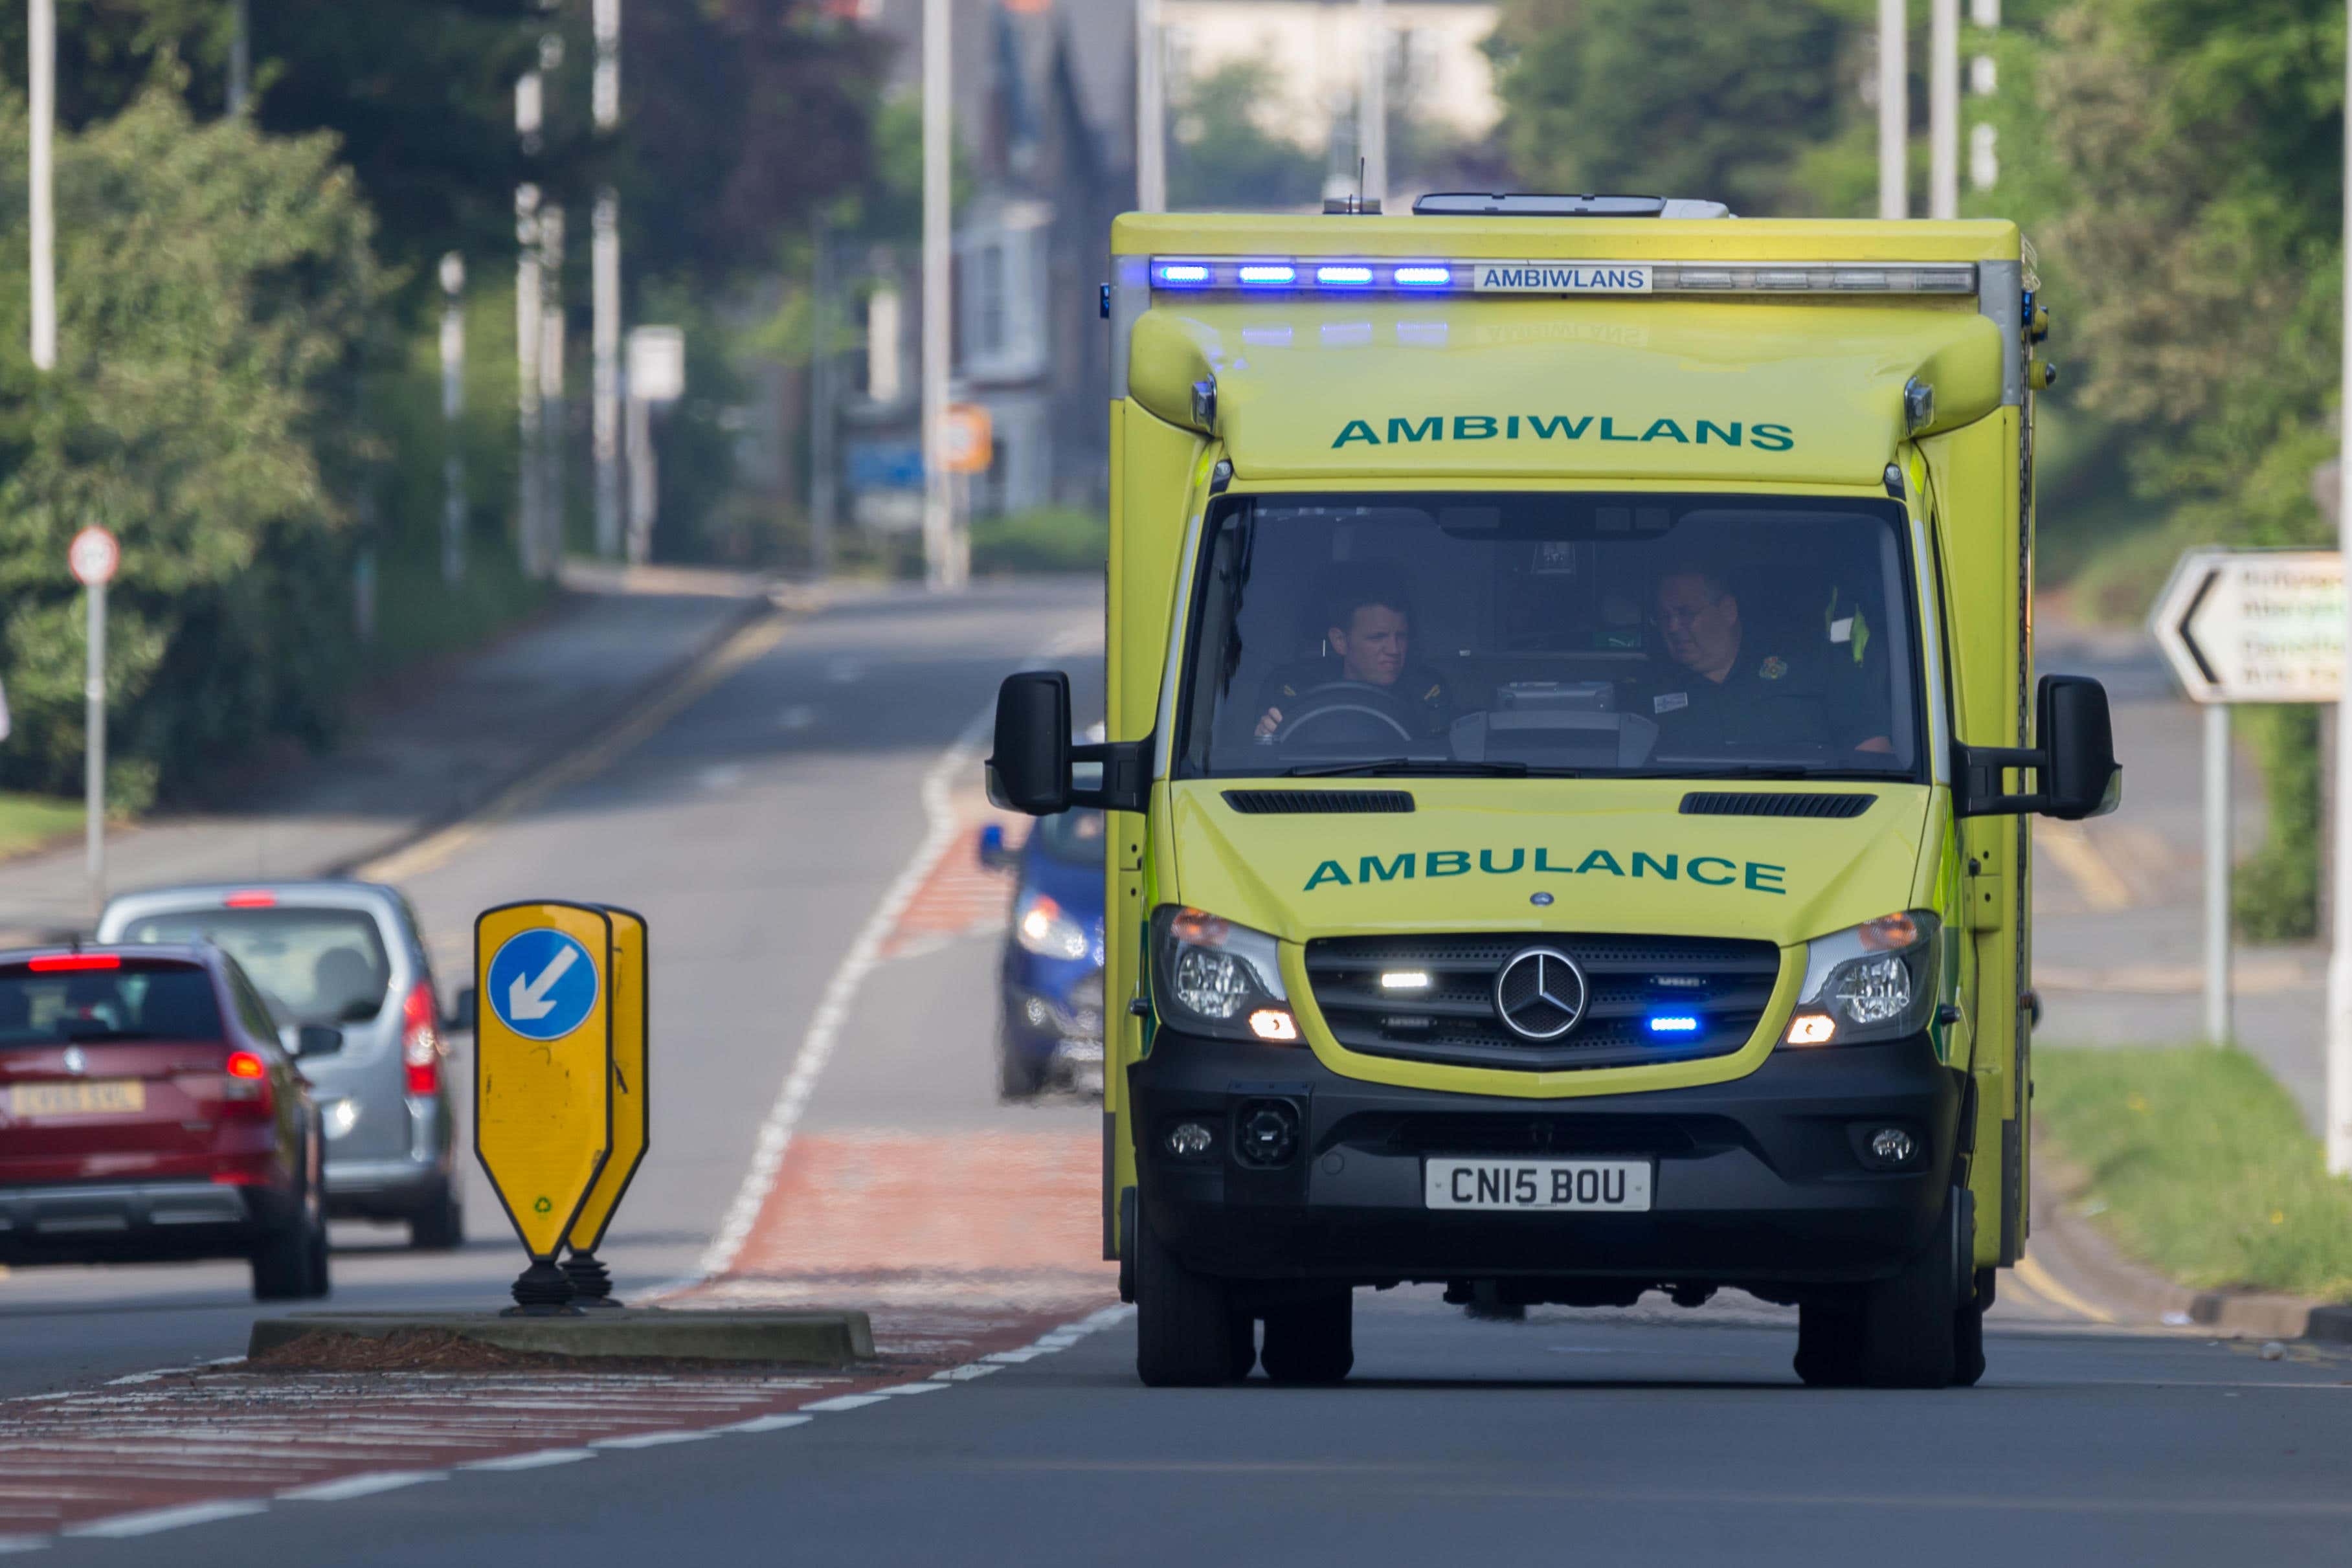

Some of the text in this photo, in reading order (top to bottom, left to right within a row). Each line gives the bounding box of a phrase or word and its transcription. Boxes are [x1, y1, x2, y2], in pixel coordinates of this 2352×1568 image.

[1483, 269, 1644, 289] AMBIWLANS
[1331, 416, 1795, 451] AMBIWLANS
[1303, 847, 1787, 895] AMBULANCE
[1451, 1167, 1626, 1204] CN15 BOU
